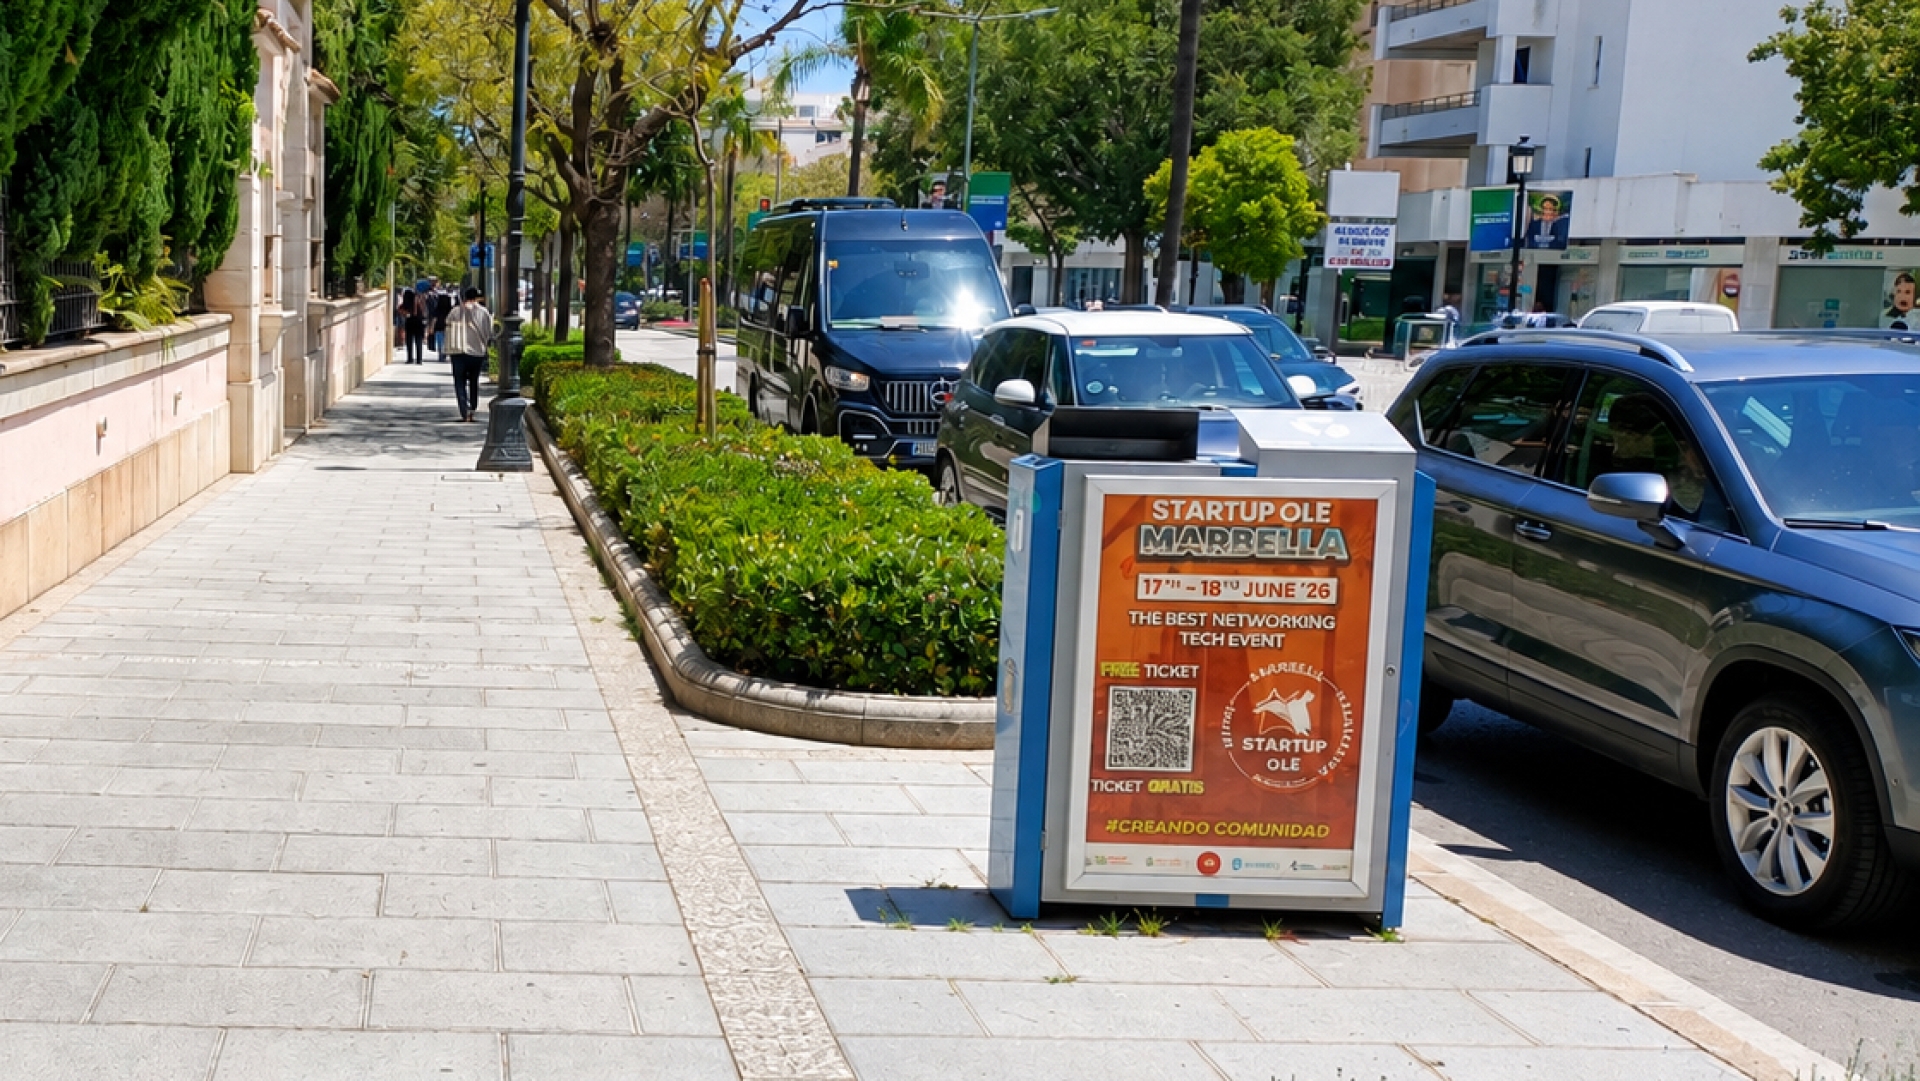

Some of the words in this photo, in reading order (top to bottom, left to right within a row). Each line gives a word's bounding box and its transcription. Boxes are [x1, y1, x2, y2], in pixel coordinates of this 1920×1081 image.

[1152, 499, 1276, 523] STARTUP
[1279, 502, 1332, 523] OLE
[1139, 524, 1350, 561] MARBELLA
[1243, 581, 1296, 598] JUNE
[1128, 610, 1163, 626] THE
[1164, 612, 1208, 627] BEST
[1212, 613, 1336, 630] NETWORKING
[1179, 631, 1225, 646] TECH
[1228, 633, 1286, 648] EVENT
[1144, 663, 1200, 679] TICKET
[1241, 737, 1328, 753] STARTUP
[1266, 757, 1301, 772] OLE
[1091, 779, 1144, 793] TICKET
[1147, 779, 1205, 794] GRATIS
[1105, 819, 1210, 836] #CREANDO
[1214, 821, 1331, 839] COMUNIDAD
